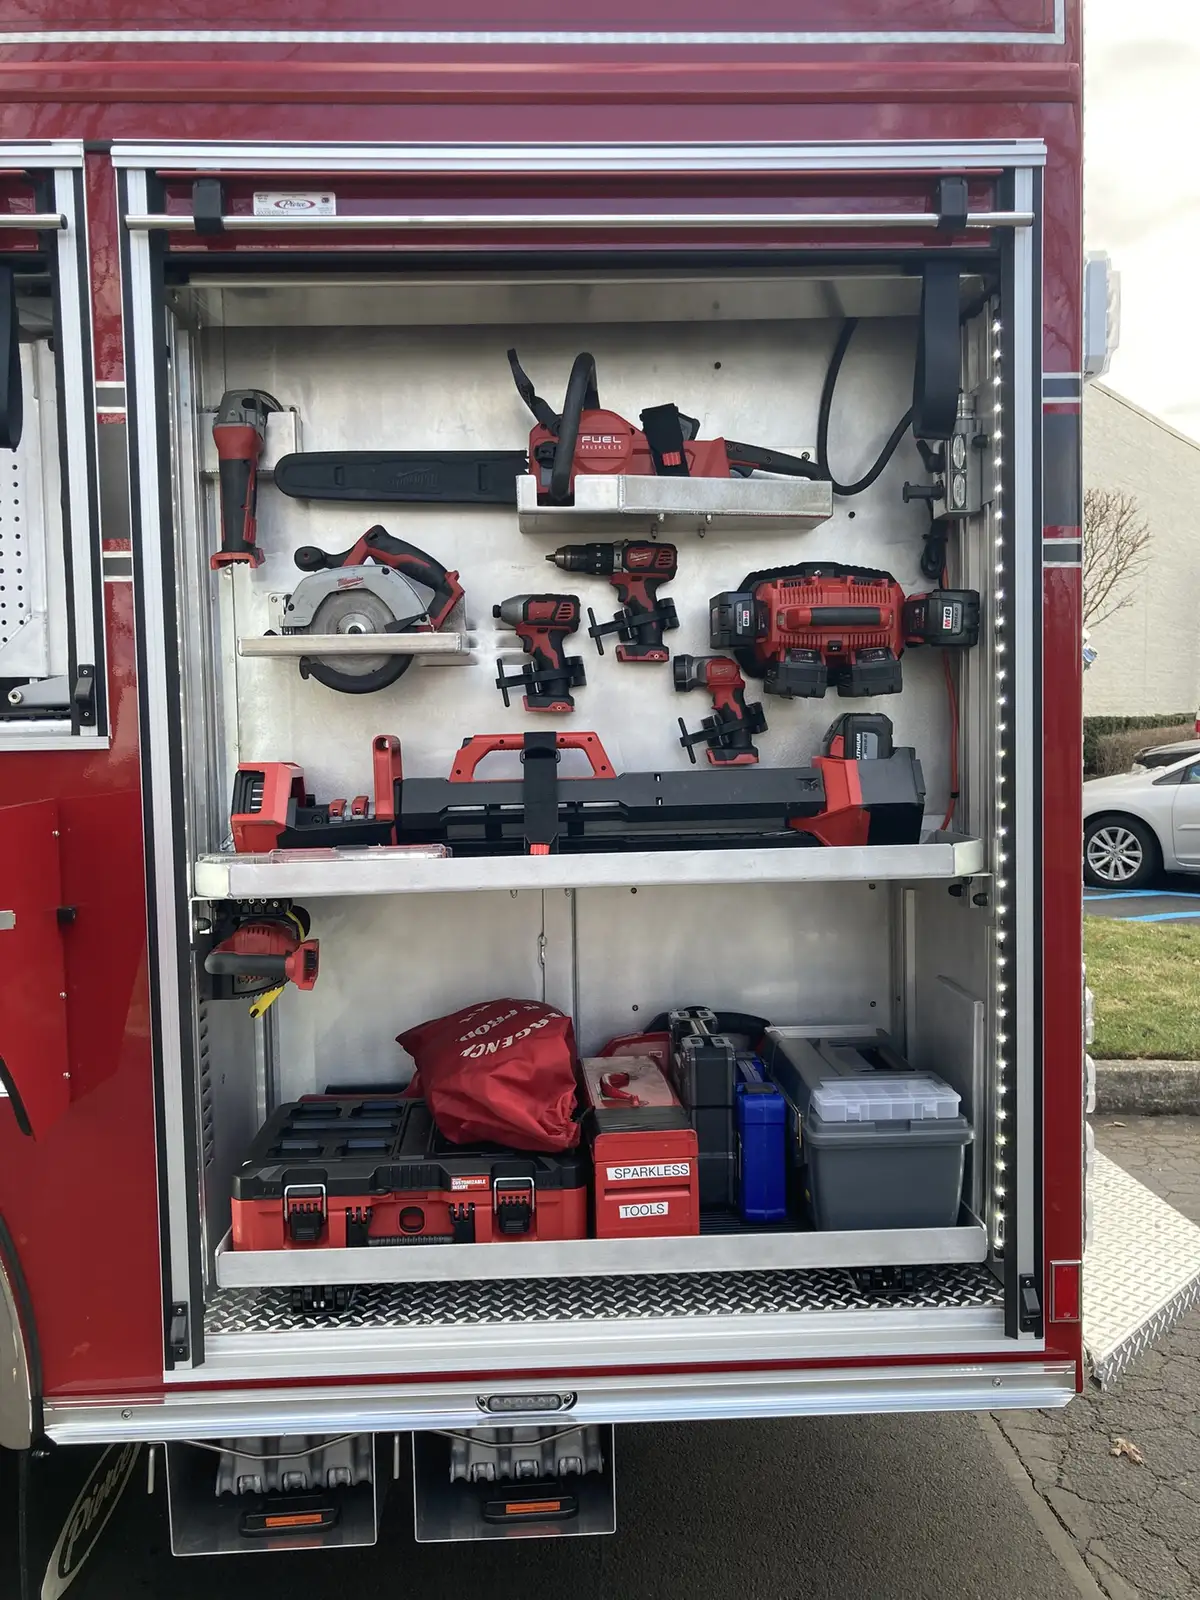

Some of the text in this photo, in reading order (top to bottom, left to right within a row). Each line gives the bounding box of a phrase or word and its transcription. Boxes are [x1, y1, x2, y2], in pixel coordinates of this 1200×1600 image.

[581, 435, 622, 443] FUEL
[944, 607, 952, 628] M18
[614, 1164, 689, 1179] SPARKLESS
[622, 1203, 665, 1217] TOOLS
